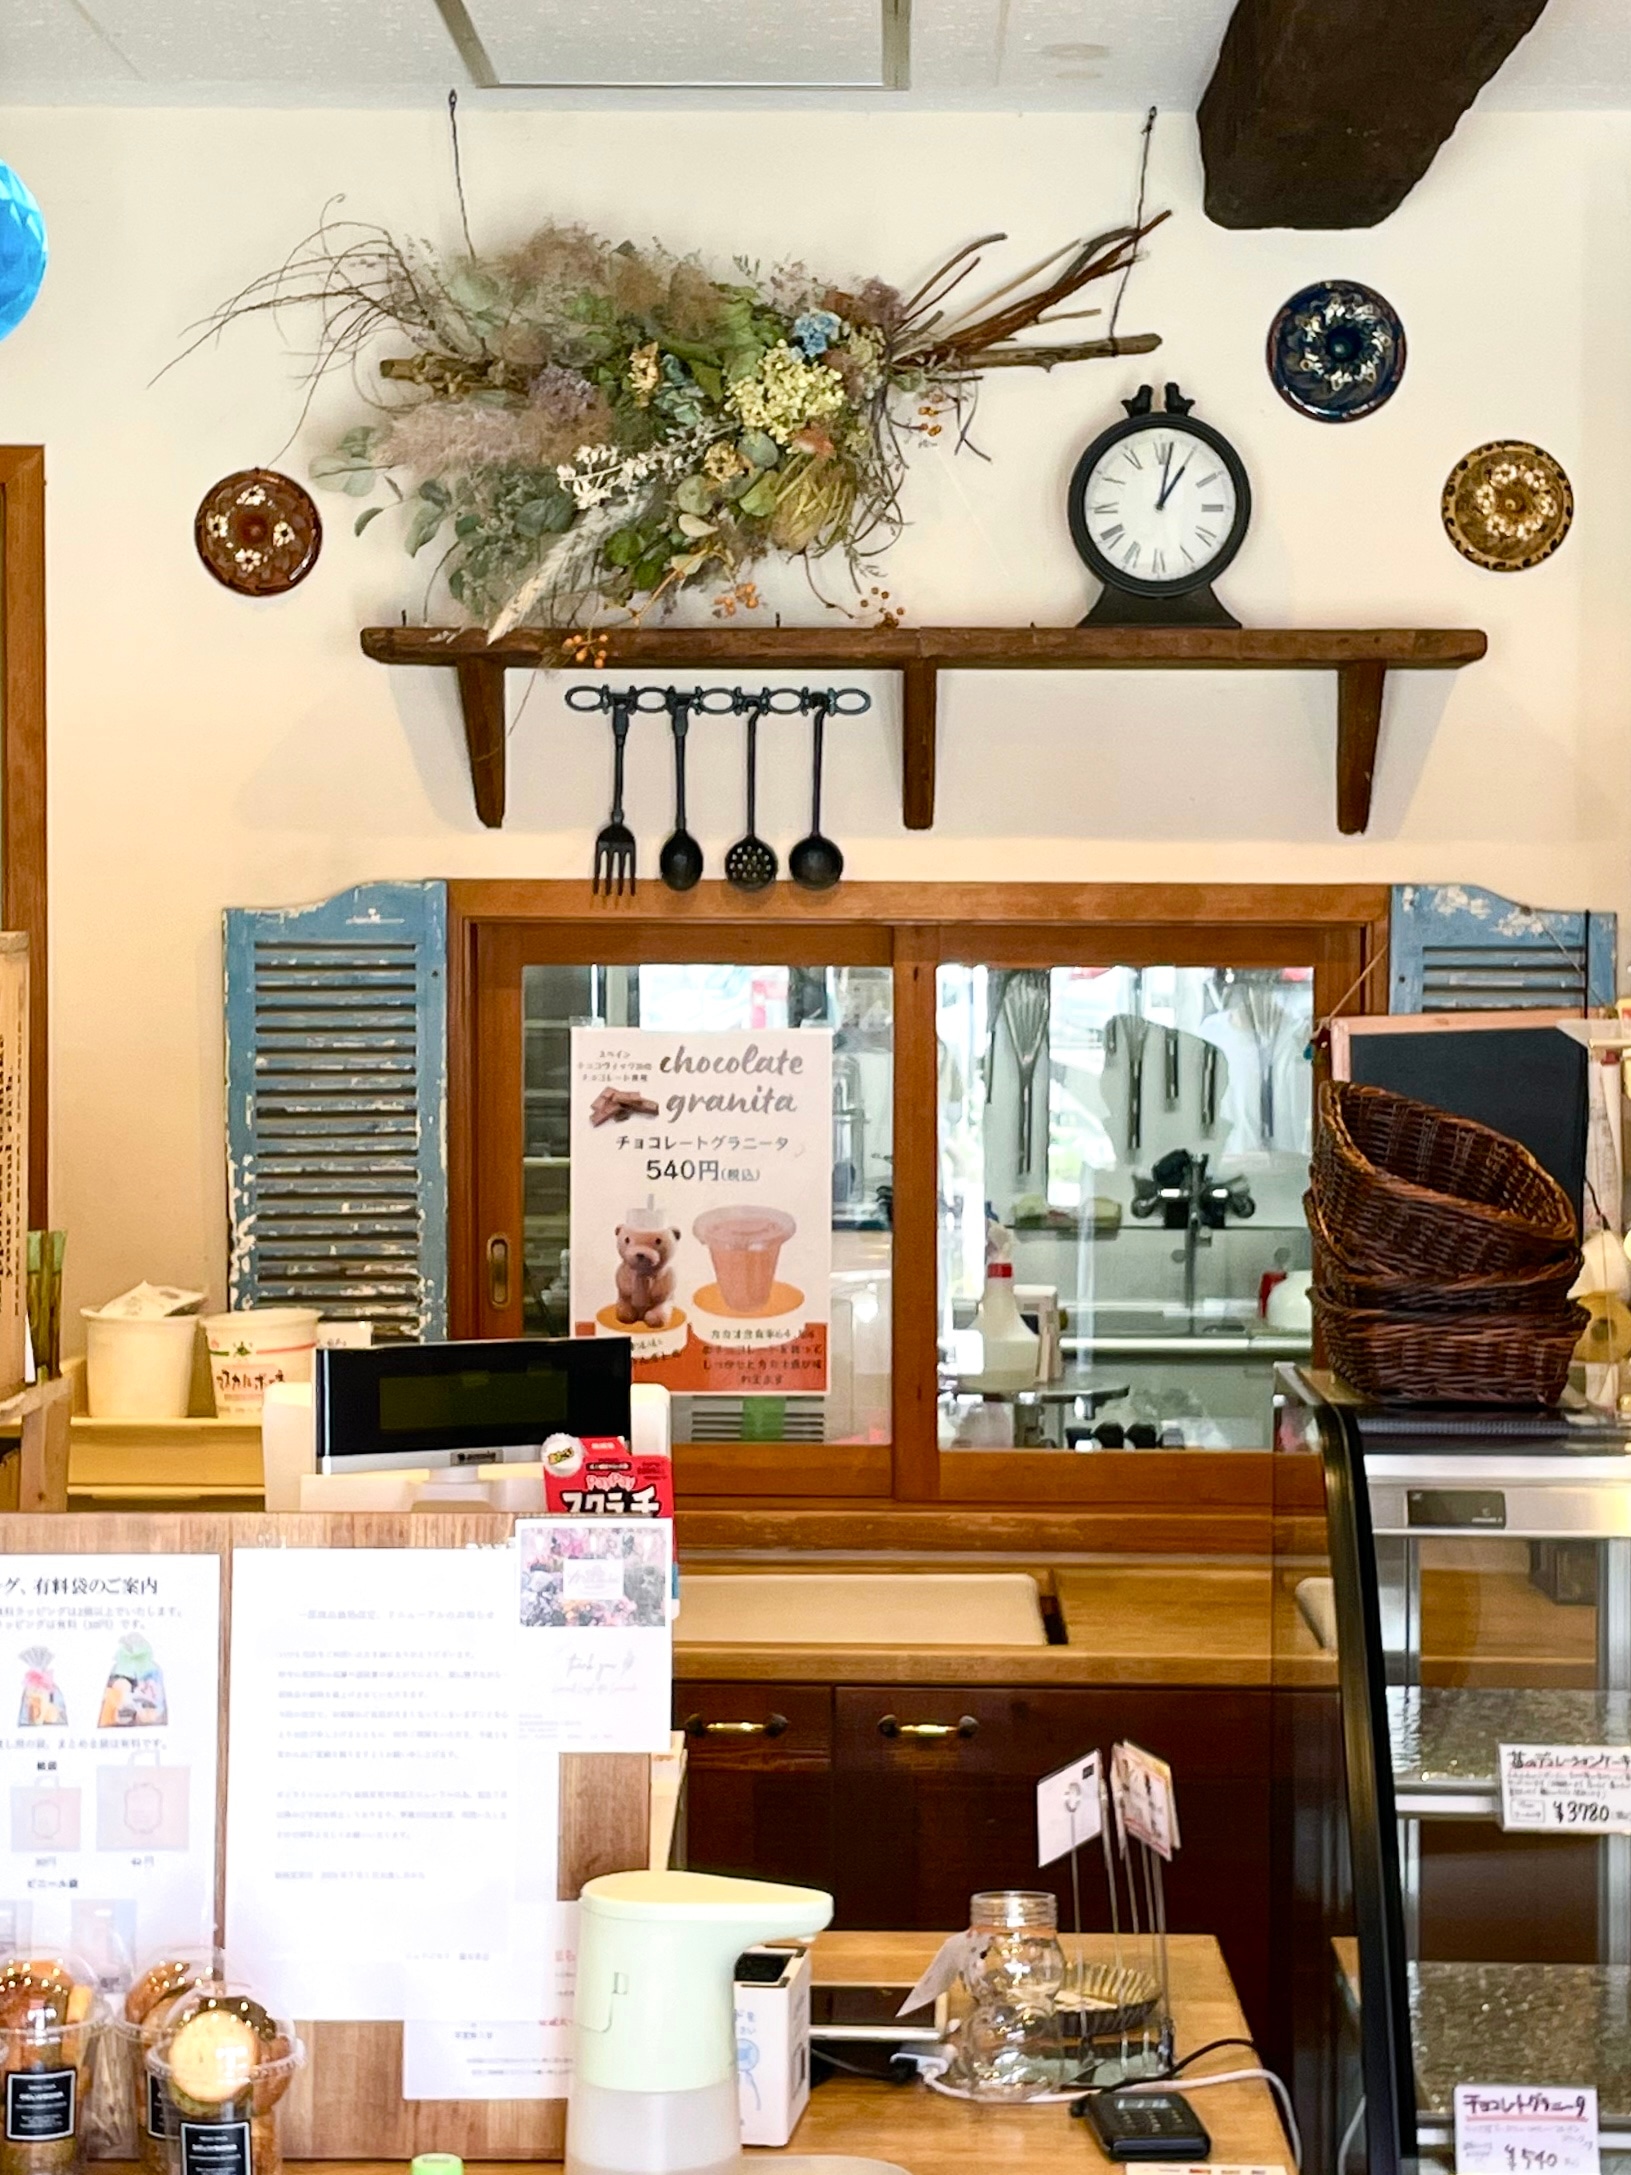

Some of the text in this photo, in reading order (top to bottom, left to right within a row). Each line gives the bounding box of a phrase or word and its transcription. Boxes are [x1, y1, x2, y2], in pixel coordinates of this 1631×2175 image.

[659, 1044, 804, 1075] chocolate
[665, 1085, 797, 1123] granita
[615, 1135, 789, 1151] チョコレートグラニータ
[586, 1472, 636, 1492] PayPay
[0, 1576, 158, 1596] グ、有料袋のご案内
